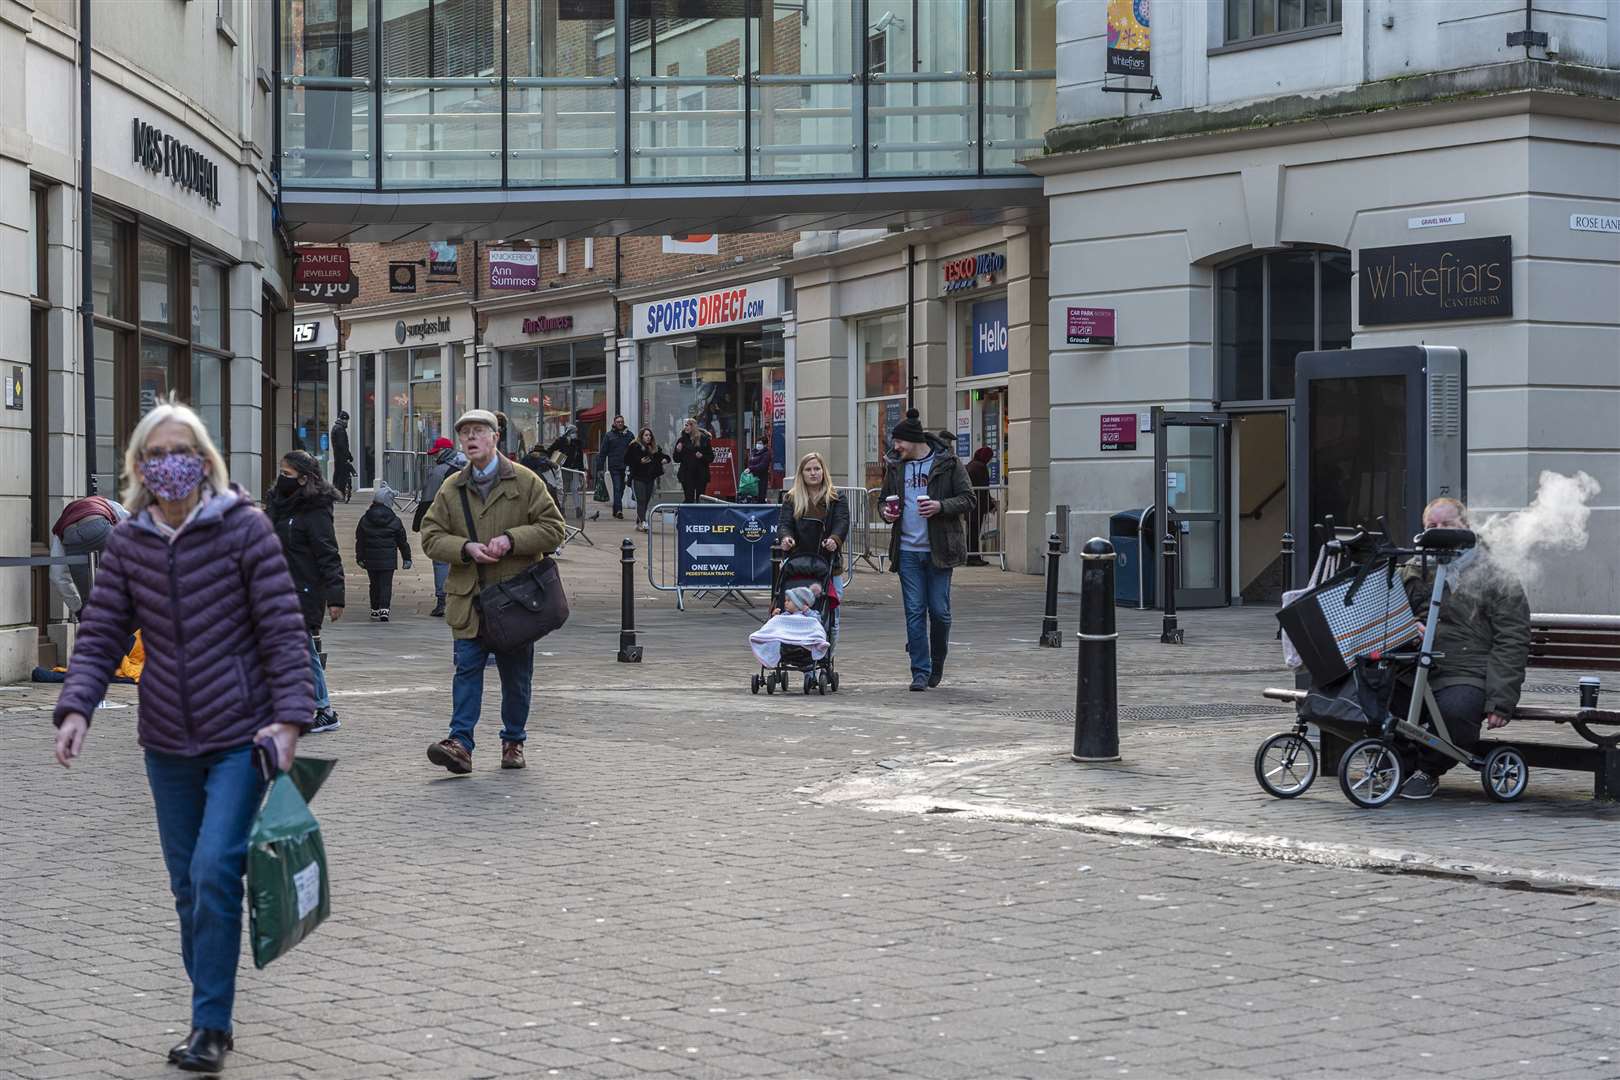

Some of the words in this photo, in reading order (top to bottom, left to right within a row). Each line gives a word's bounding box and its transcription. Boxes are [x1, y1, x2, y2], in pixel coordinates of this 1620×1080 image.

[133, 117, 163, 174] M&S
[164, 134, 221, 206] FOODHALL
[1421, 218, 1438, 226] GRAVEL
[1438, 216, 1452, 224] WALK
[1576, 216, 1599, 229] ROSE
[491, 266, 512, 276] Ann
[944, 256, 977, 281] TESCO
[976, 252, 1005, 275] Metro
[304, 270, 341, 278] JEWELLERS
[1367, 252, 1502, 308] Whitefriars
[491, 275, 537, 287] Summers
[1444, 295, 1501, 308] CANTERBURY
[406, 318, 437, 341] sunglass
[437, 315, 451, 333] hut
[979, 320, 1008, 354] Hello
[1070, 336, 1090, 344] Ground
[685, 525, 711, 533] KEEP
[711, 525, 736, 533] LEFT
